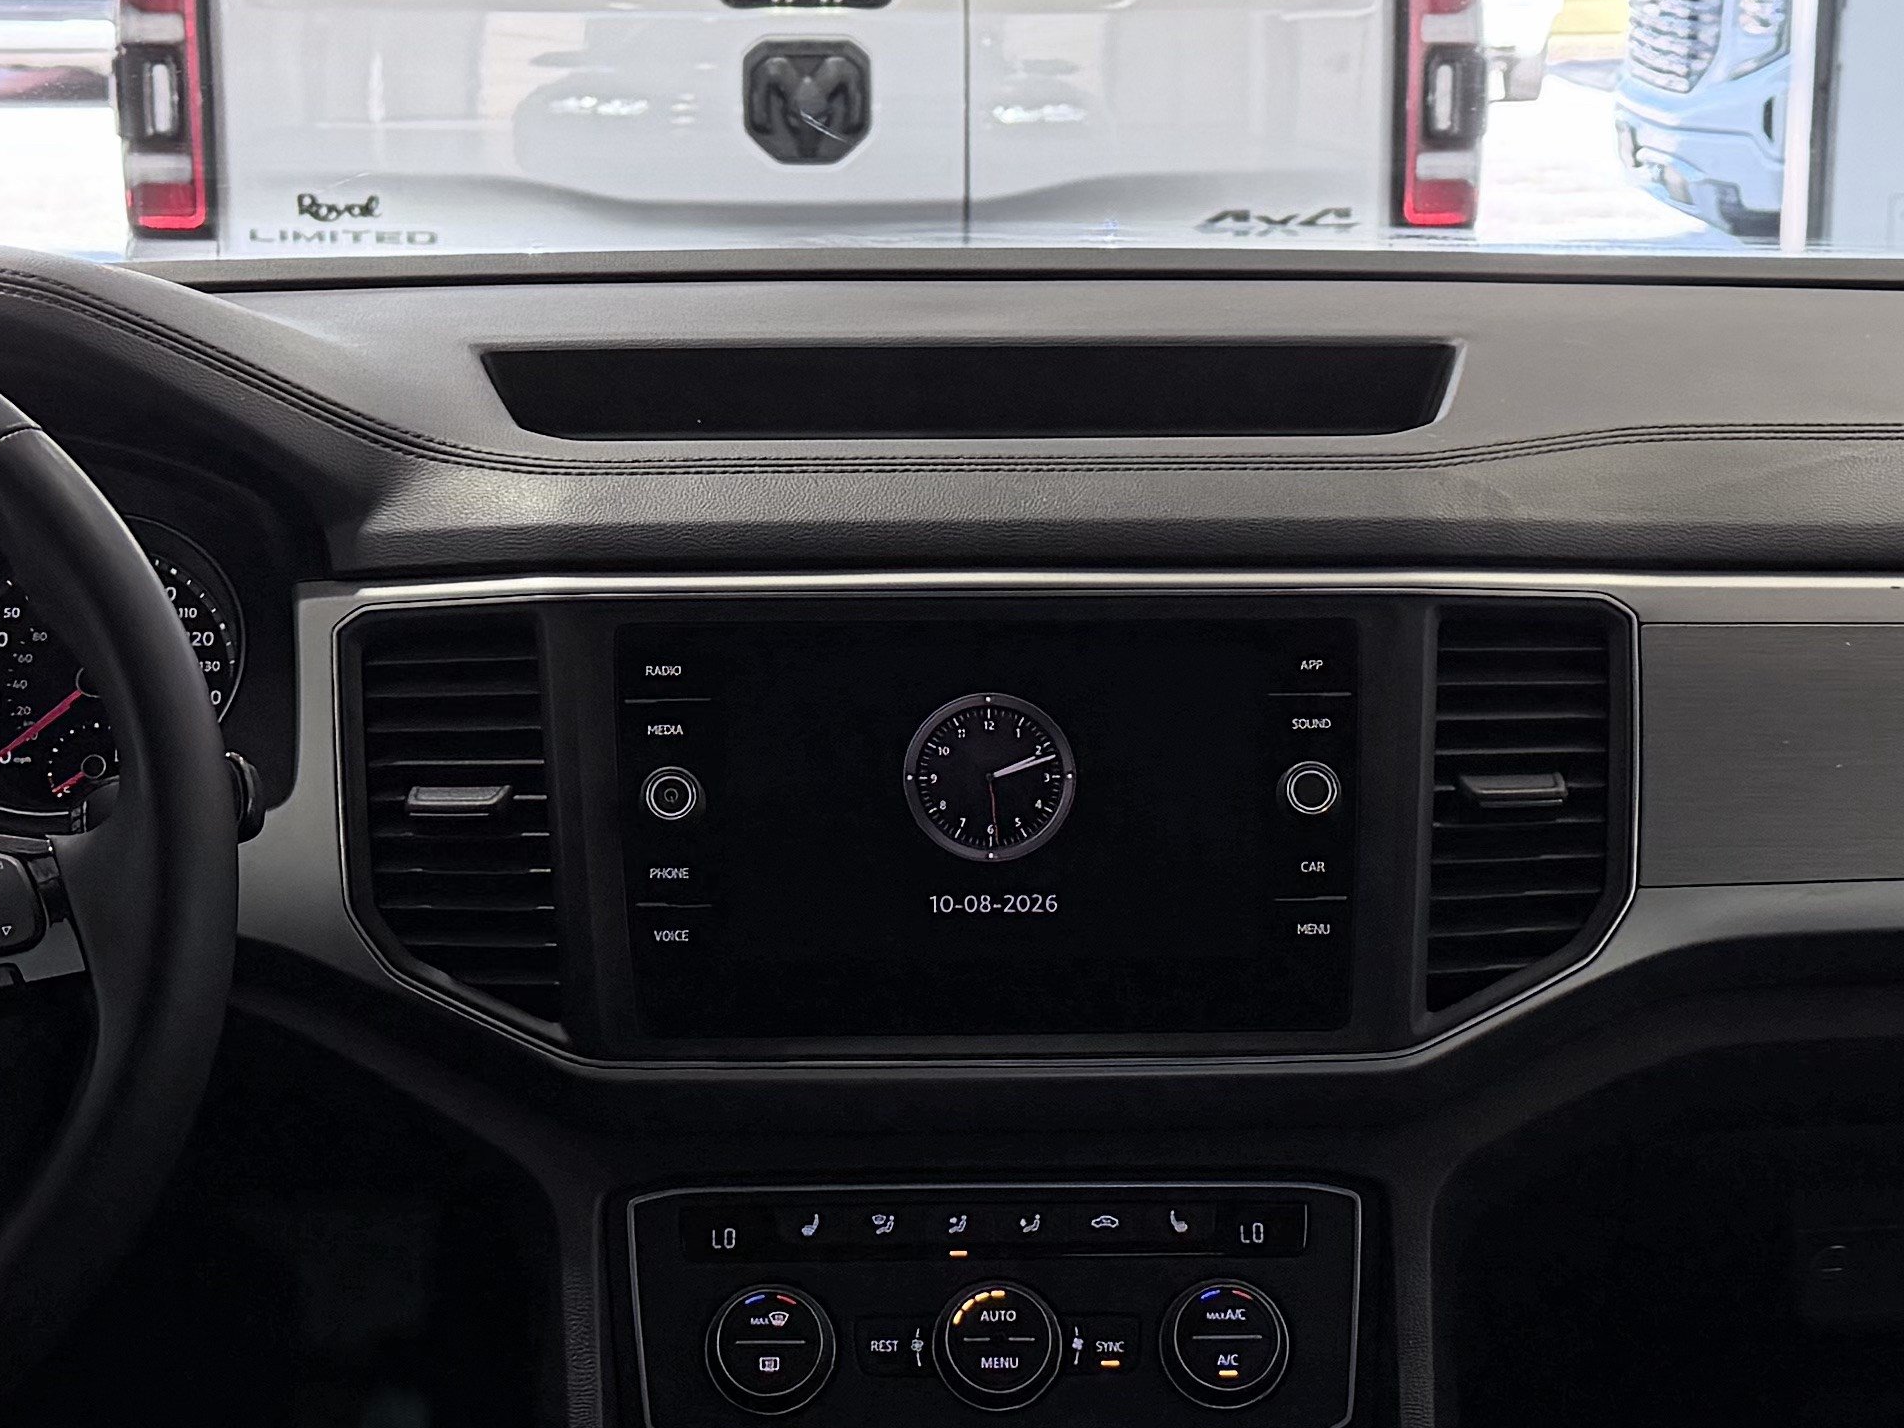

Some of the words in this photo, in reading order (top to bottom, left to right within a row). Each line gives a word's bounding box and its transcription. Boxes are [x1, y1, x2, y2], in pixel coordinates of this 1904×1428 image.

[297, 193, 382, 222] Royal
[249, 228, 438, 244] LIMITED
[3, 607, 20, 619] 50
[32, 632, 47, 642] 80
[17, 654, 33, 664] 60
[645, 663, 683, 678] RADIO
[1299, 659, 1325, 673] APP
[12, 679, 28, 690] 40
[17, 705, 32, 716] 20
[647, 722, 685, 737] MEDIA
[984, 721, 995, 731] 12
[1291, 716, 1333, 731] SOUND
[1015, 728, 1021, 738] 1
[938, 746, 950, 756] 10
[1035, 745, 1042, 755] 2
[930, 774, 938, 783] 9
[1044, 773, 1050, 782] 3
[939, 800, 947, 810] 8
[1034, 799, 1042, 809] 4
[959, 817, 967, 827] 7
[1014, 817, 1021, 827] 5
[986, 824, 994, 835] 6
[649, 866, 690, 881] PHONE
[1300, 860, 1327, 874] CAR
[929, 894, 1058, 914] 10-08-2026
[1296, 922, 1331, 937] MENU
[653, 929, 690, 944] VOICE
[980, 1310, 1017, 1323] AUTO
[1225, 1308, 1247, 1321] A/C
[870, 1340, 899, 1353] REST
[1096, 1340, 1125, 1353] SYNC
[981, 1356, 1019, 1369] MENU
[1217, 1353, 1239, 1367] A/C
